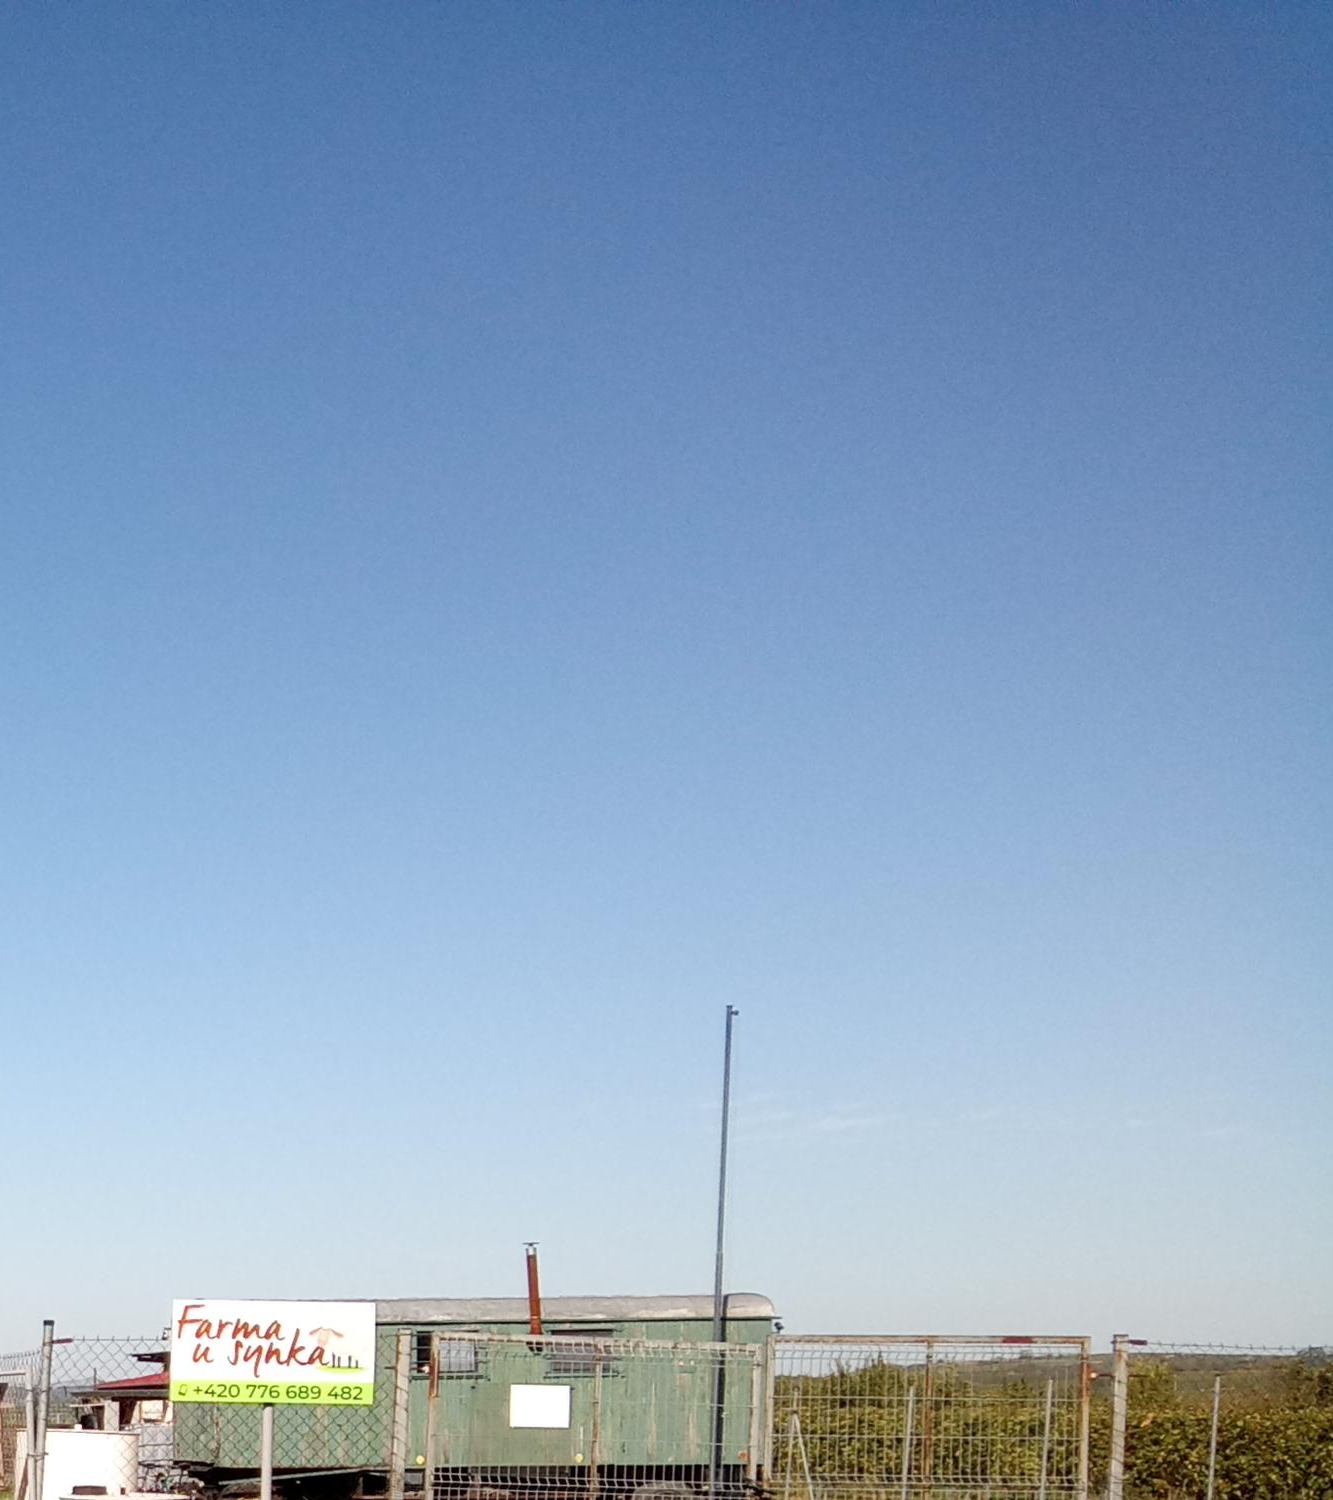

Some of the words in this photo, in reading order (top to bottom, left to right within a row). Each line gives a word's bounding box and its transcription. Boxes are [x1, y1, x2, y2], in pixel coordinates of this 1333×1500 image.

[177, 1304, 285, 1341] Farma
[192, 1342, 214, 1363] u
[227, 1328, 330, 1378] synka
[193, 1384, 240, 1398] +420
[246, 1385, 280, 1399] 776
[286, 1385, 321, 1400] 689
[327, 1386, 364, 1401] 482
